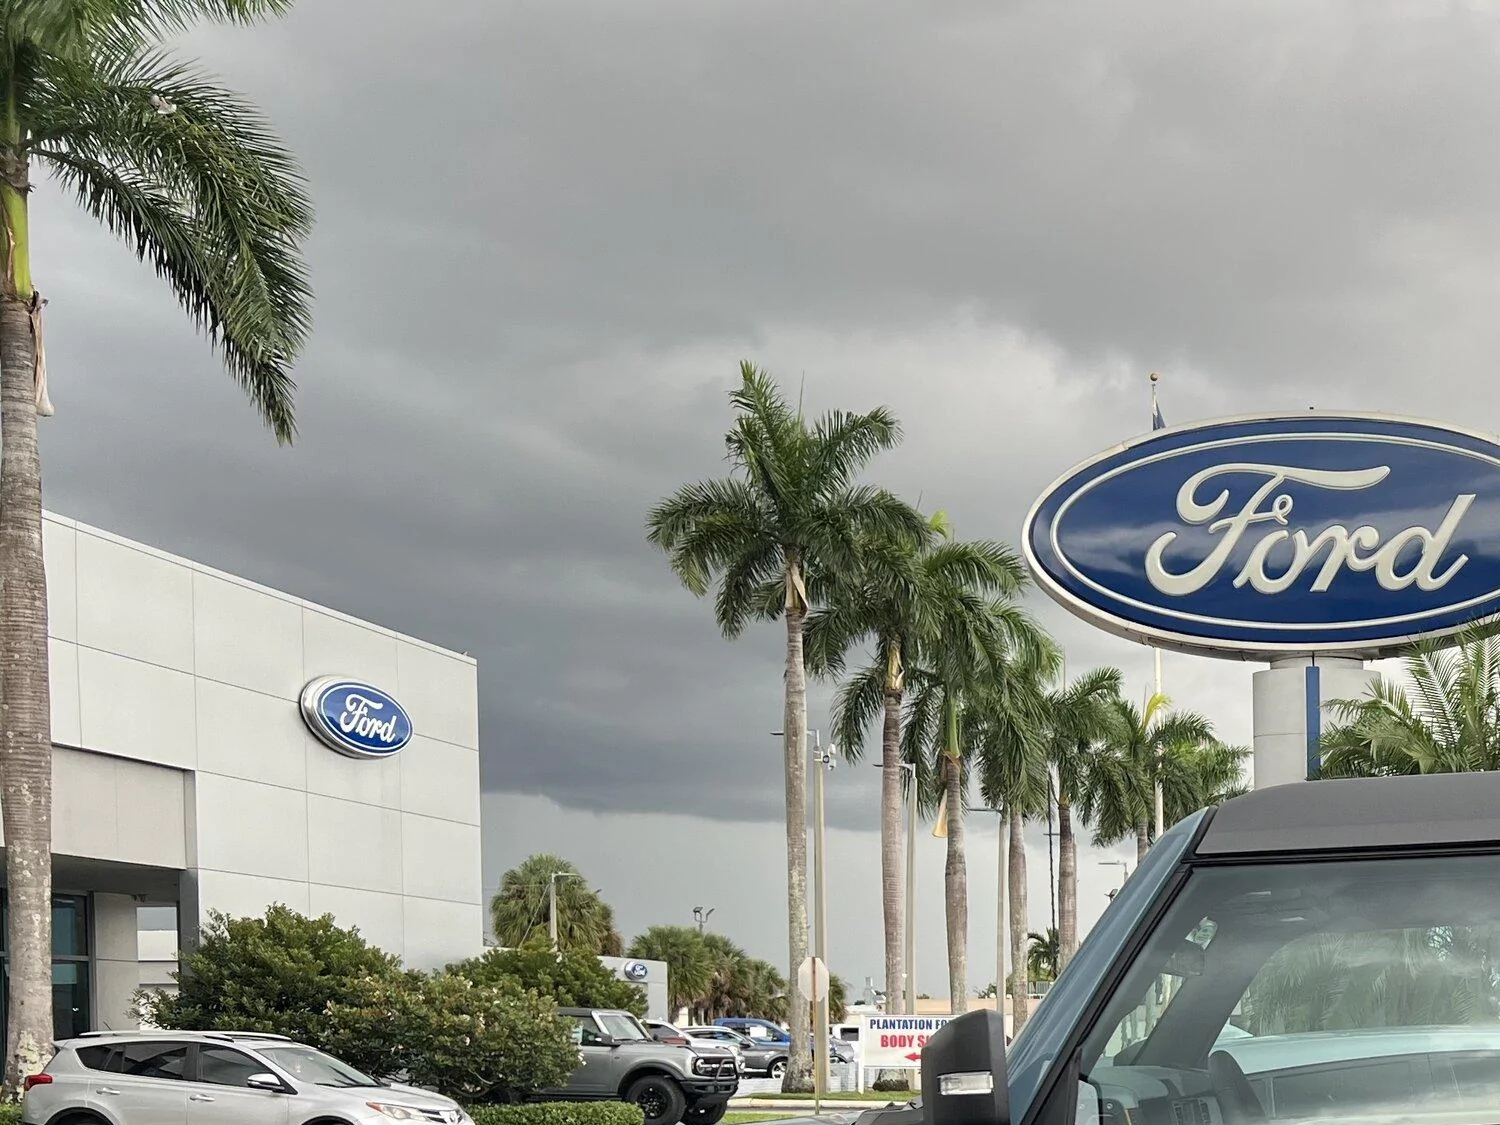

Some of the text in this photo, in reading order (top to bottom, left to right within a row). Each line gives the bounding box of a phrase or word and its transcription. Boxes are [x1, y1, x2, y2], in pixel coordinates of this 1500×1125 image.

[1145, 462, 1477, 597] Ford
[339, 693, 397, 743] Ford
[869, 1019, 932, 1030] PLANTATION
[880, 1034, 915, 1048] BODY
